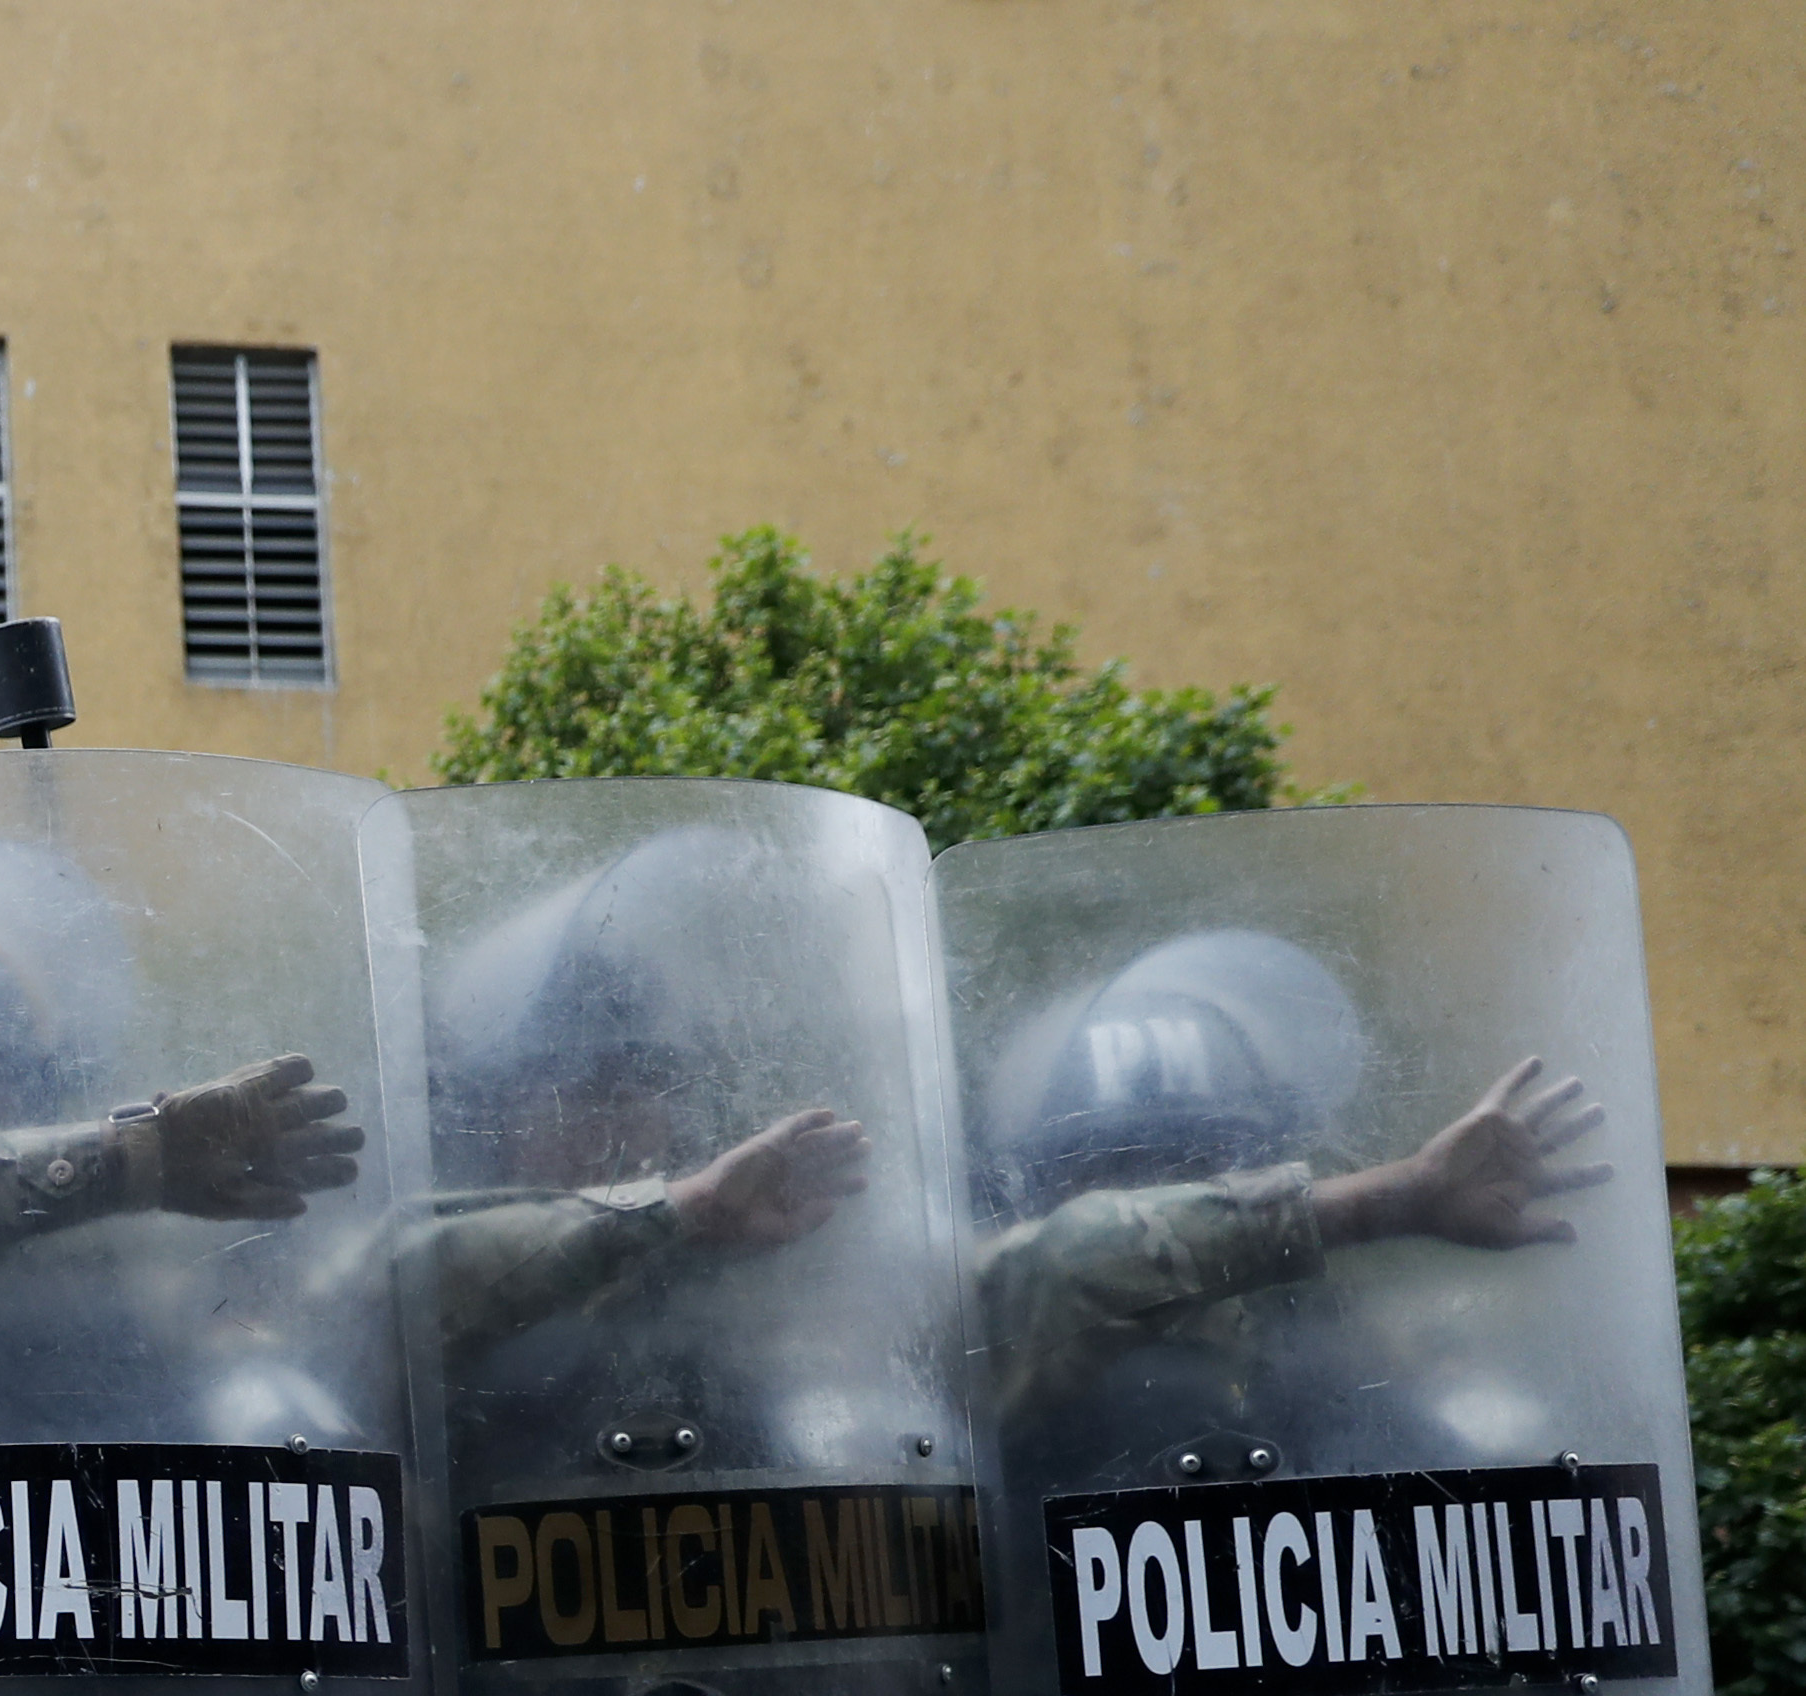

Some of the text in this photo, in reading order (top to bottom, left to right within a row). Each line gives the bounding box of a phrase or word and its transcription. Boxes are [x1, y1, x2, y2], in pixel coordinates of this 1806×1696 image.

[1088, 1017, 1213, 1102] PM
[117, 1479, 391, 1644] MILITAR
[476, 1502, 795, 1649] POLICIA
[1074, 1496, 1661, 1677] POLICIA MILITAR
